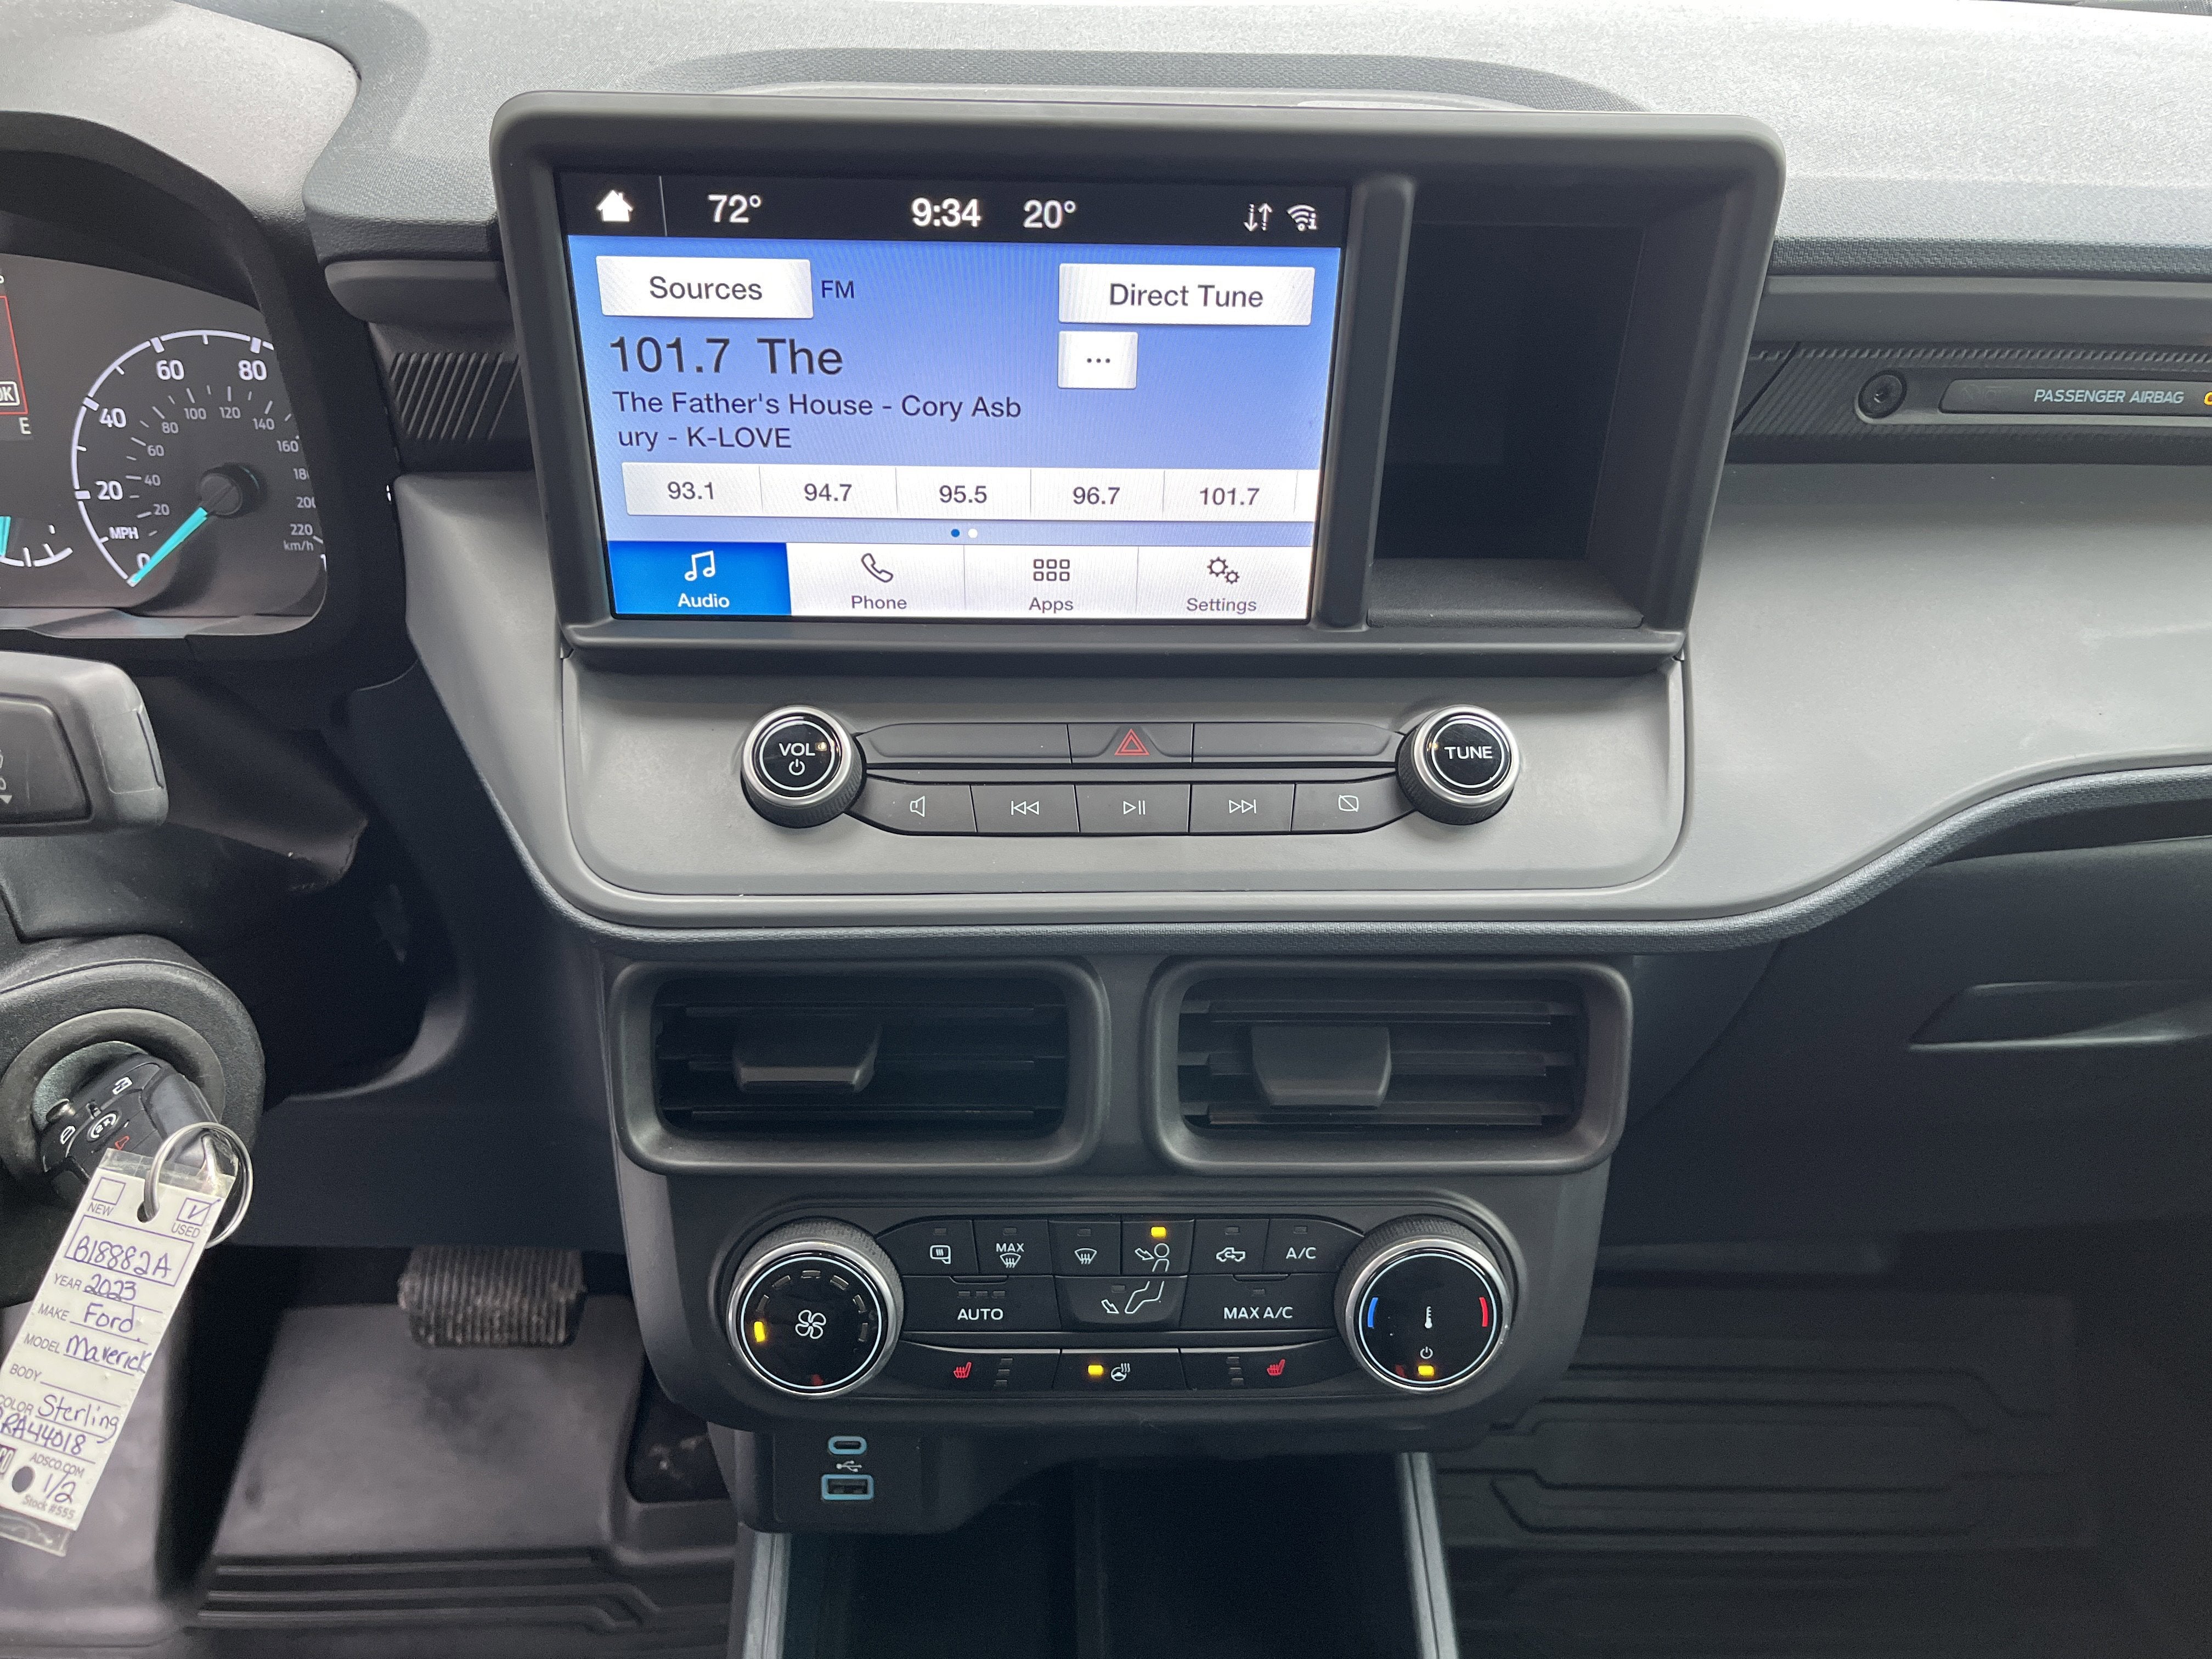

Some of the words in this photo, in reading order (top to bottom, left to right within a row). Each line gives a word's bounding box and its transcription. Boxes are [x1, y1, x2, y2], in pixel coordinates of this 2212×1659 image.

[708, 194, 762, 223] 72°
[912, 198, 981, 228] 9:34
[1023, 200, 1076, 229] 20°
[649, 276, 763, 300] Sources
[821, 280, 855, 299] FM
[1110, 283, 1189, 306] Direct
[1198, 285, 1263, 307] Tune
[609, 336, 730, 373] 101.7
[757, 338, 843, 375] The
[156, 359, 184, 381] 60
[238, 360, 267, 381] 80
[2034, 389, 2126, 404] PASSENGER
[2129, 390, 2184, 404] AIRBAG
[184, 408, 207, 420] 100
[219, 407, 241, 419] 120
[612, 391, 663, 413] The
[672, 392, 780, 414] Father's
[789, 394, 873, 415] House
[901, 396, 963, 422] Cory
[971, 397, 1022, 419] Asb
[19, 417, 31, 435] E
[99, 407, 126, 428] 40
[252, 418, 275, 430] 140
[162, 422, 179, 434] 80
[276, 440, 299, 453] 160
[617, 430, 658, 453] ury
[687, 427, 792, 449] K-LOVE
[147, 445, 164, 457] 60
[144, 475, 160, 486] 40
[293, 468, 309, 481] 18
[95, 480, 123, 501] 20
[667, 481, 714, 500] 93.1
[804, 483, 852, 502] 94.7
[939, 485, 988, 504] 95.5
[1073, 487, 1120, 505] 96.7
[1200, 488, 1260, 506] 101.7
[154, 504, 170, 516] 20
[110, 526, 139, 540] MPH
[290, 523, 313, 536] 220
[283, 540, 314, 551] km/h
[678, 593, 730, 608] Audio
[851, 595, 907, 610] Phone
[1029, 597, 1074, 614] Apps
[1186, 597, 1257, 614] Settings
[778, 742, 816, 757] VOL
[1444, 746, 1493, 759] TUNE
[87, 1201, 114, 1216] NEW
[171, 1222, 201, 1238] USED
[996, 1243, 1025, 1252] MAX
[1285, 1246, 1317, 1260] A/C
[54, 1273, 82, 1291] YEAR
[82, 1273, 137, 1301] 2023
[37, 1303, 70, 1321] MAKE
[83, 1302, 136, 1333] Ford
[957, 1307, 1004, 1321] AUTO
[1223, 1307, 1260, 1319] MAX
[1262, 1306, 1293, 1319] A/C
[24, 1333, 60, 1354] MODEL
[65, 1334, 152, 1374] Maverick
[9, 1363, 42, 1381] BODY
[38, 1394, 119, 1444] Sterling
[0, 1406, 86, 1455] RA44018
[30, 1452, 85, 1478] ADSCO.COM
[22, 1494, 48, 1511] Stock
